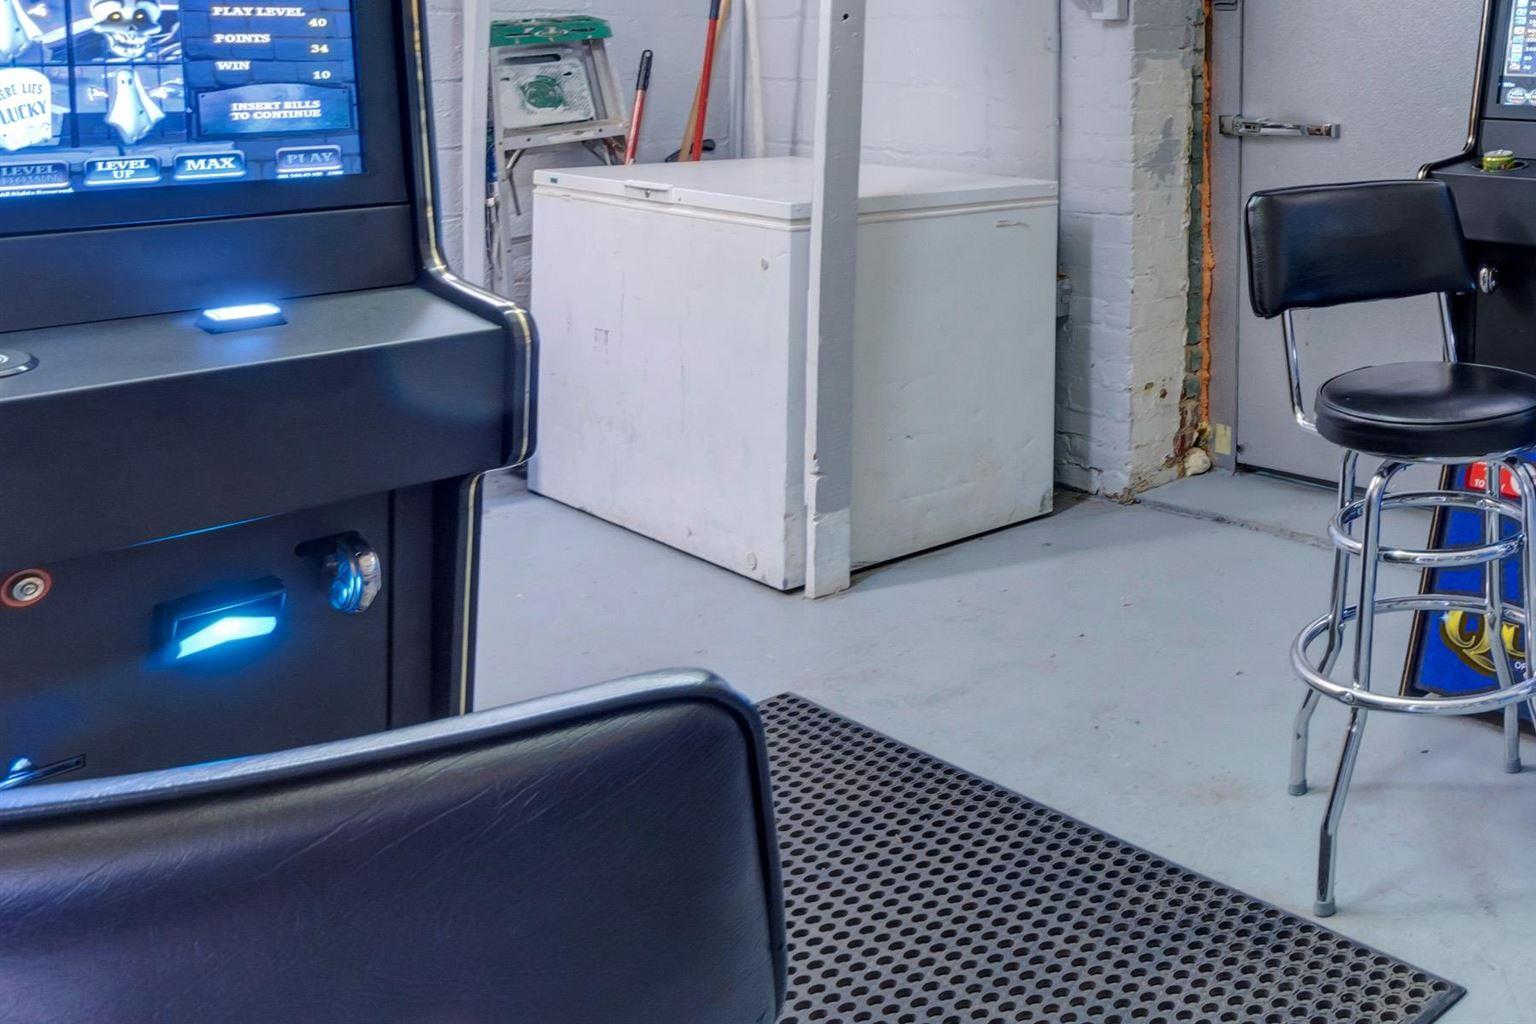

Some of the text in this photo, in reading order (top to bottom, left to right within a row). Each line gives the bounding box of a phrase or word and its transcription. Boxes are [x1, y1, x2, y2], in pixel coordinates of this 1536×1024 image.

[212, 7, 306, 17] PLAY LEVEL
[308, 18, 327, 27] 40
[213, 34, 271, 43] POINTS
[310, 44, 329, 53] 34
[215, 61, 251, 70] WIN
[312, 71, 331, 79] 10
[22, 83, 43, 94] LIES
[231, 100, 321, 111] INSERT BILLS
[231, 109, 322, 121] TO CONTINUE
[286, 152, 335, 163] PLAY
[97, 158, 150, 170] LEVEL
[185, 157, 236, 170] MAX
[1, 165, 58, 176] LEVEL
[112, 169, 136, 179] UP
